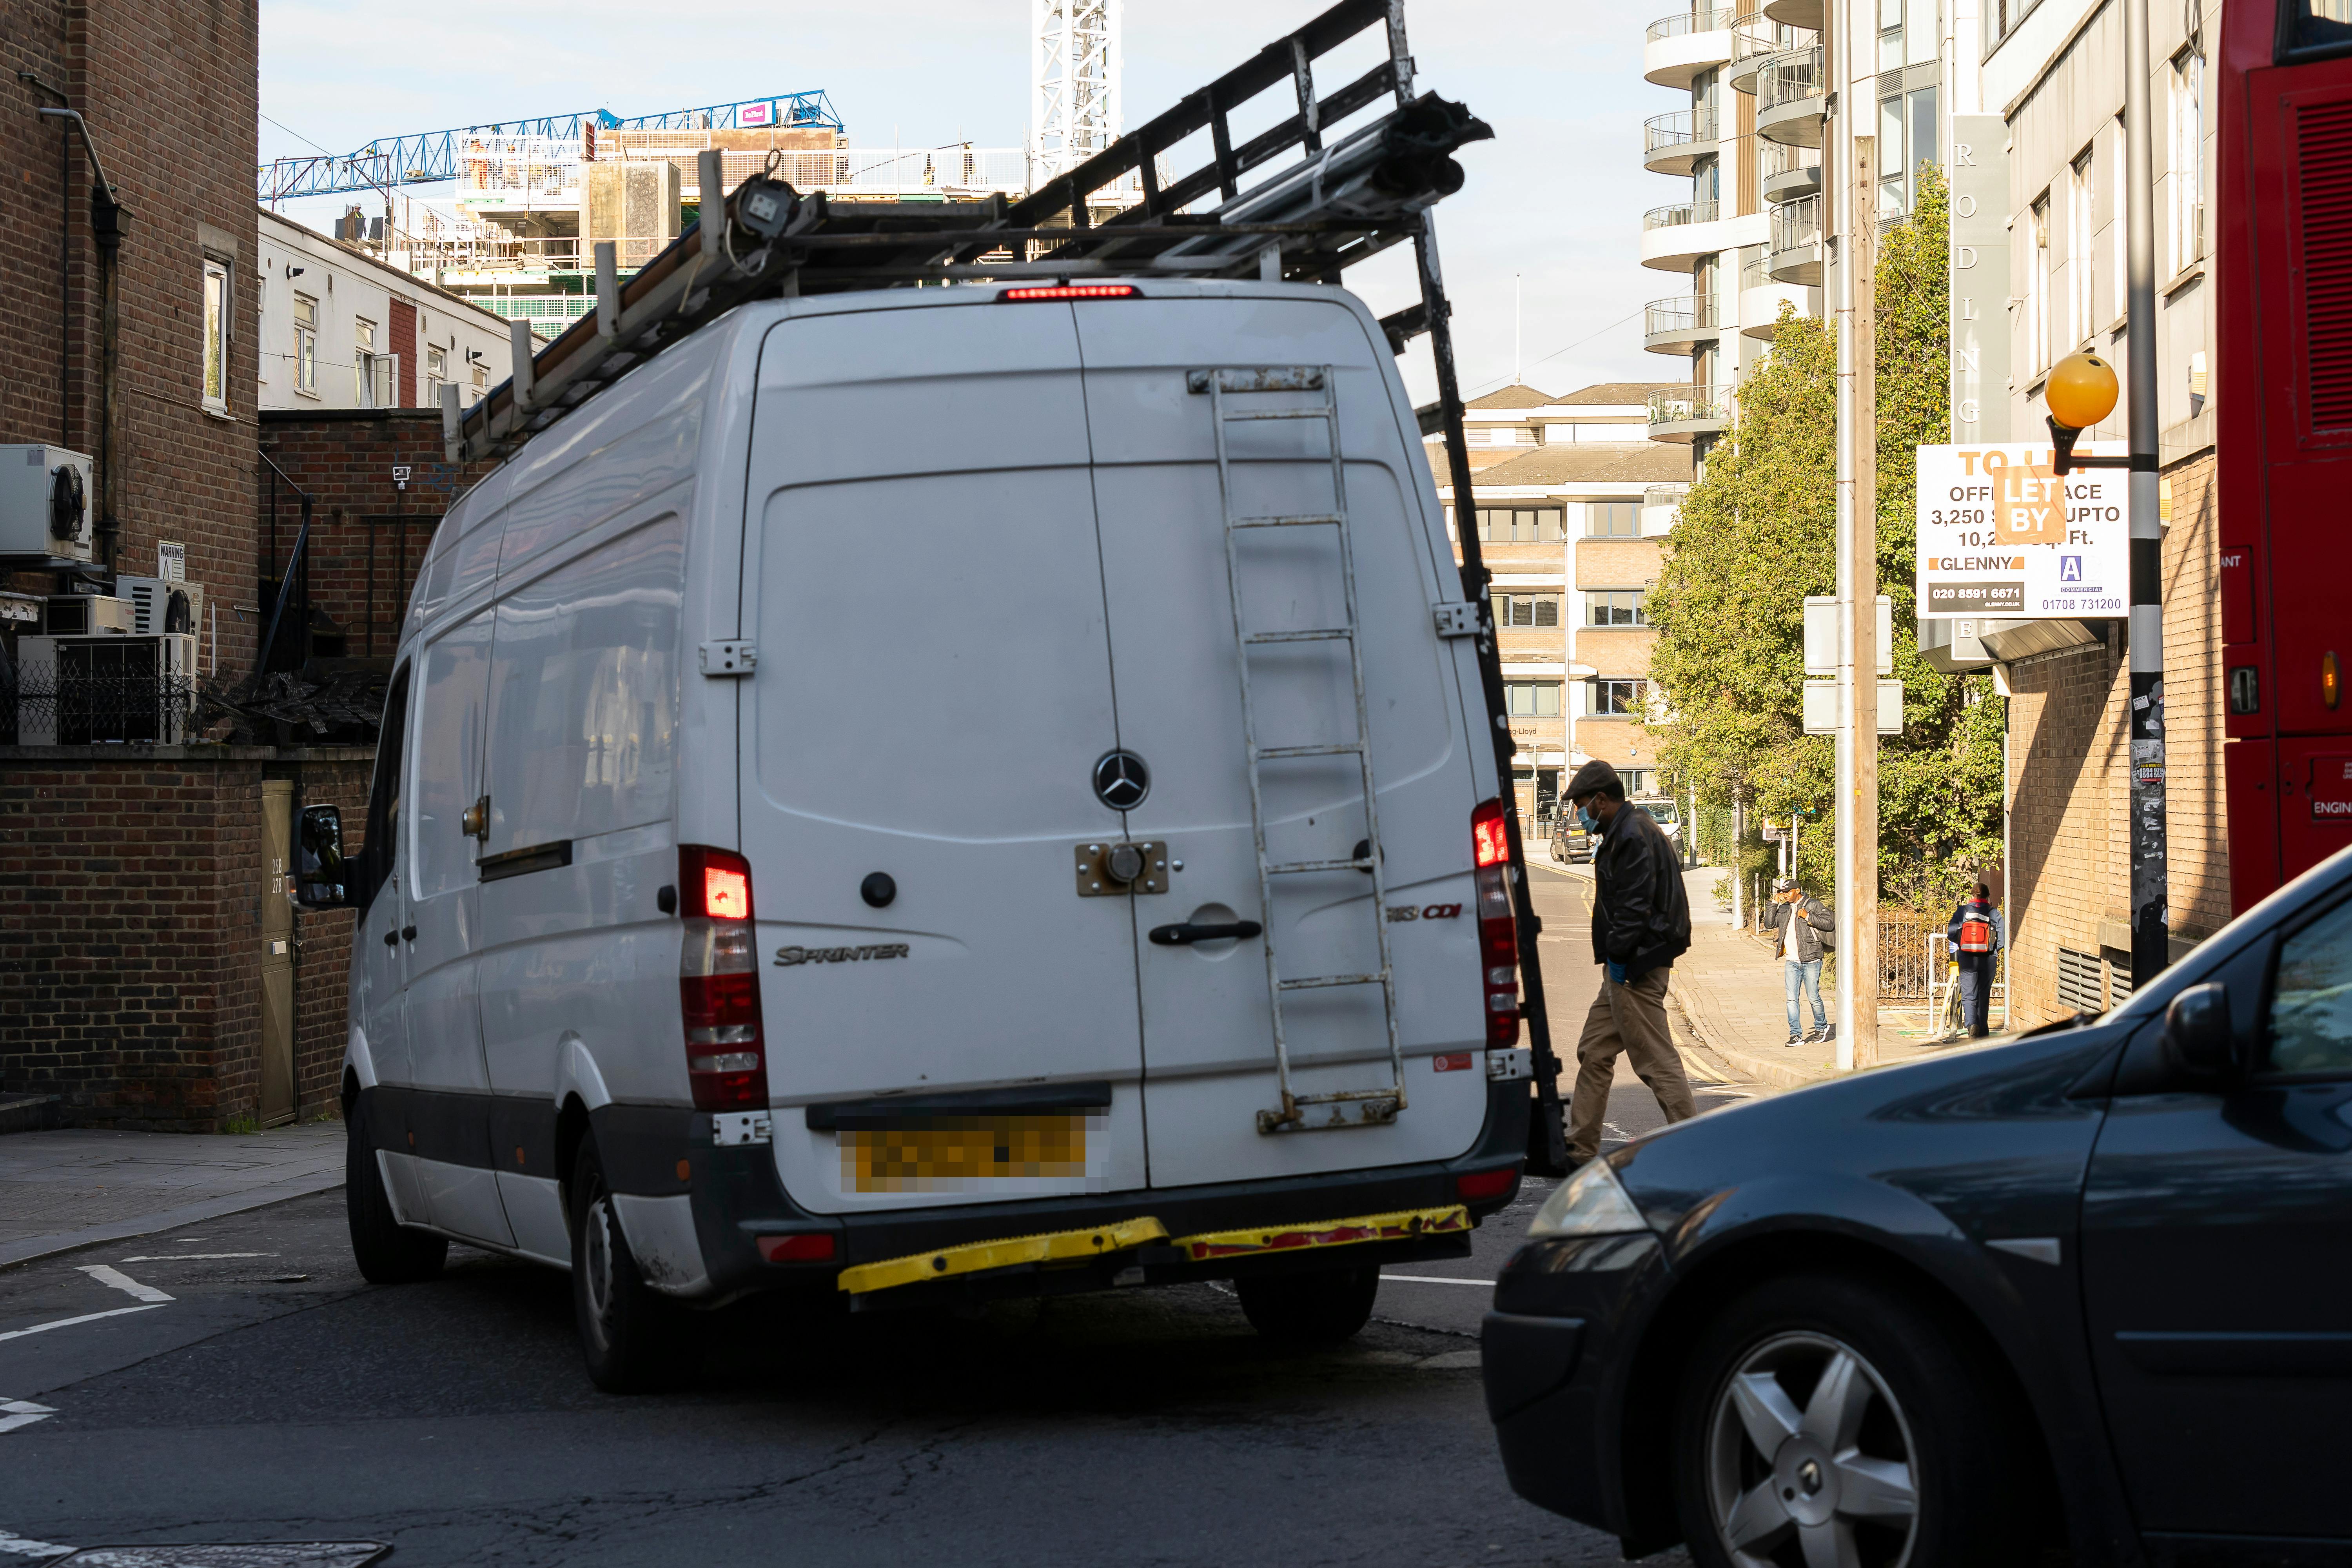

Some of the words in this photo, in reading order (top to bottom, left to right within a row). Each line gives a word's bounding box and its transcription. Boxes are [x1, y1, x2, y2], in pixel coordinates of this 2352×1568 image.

[1955, 143, 1980, 423] RODING
[2004, 478, 2057, 502] LET
[1932, 510, 1984, 526] 3,250
[2011, 508, 2050, 532] BY
[1959, 532, 1995, 549] 10,2
[2070, 530, 2093, 544] Ft.
[160, 545, 183, 559] WARNING
[1941, 557, 2011, 570] GLENNY
[1932, 589, 1955, 599] 020
[1958, 588, 1987, 599] 8591
[1991, 588, 2020, 598] 6671
[2043, 599, 2075, 609] 01708
[2081, 599, 2121, 609] 731200
[2314, 802, 2352, 813] ENGIN
[272, 858, 282, 874] 25B
[272, 878, 282, 893] 27B
[1422, 903, 1462, 920] CDI
